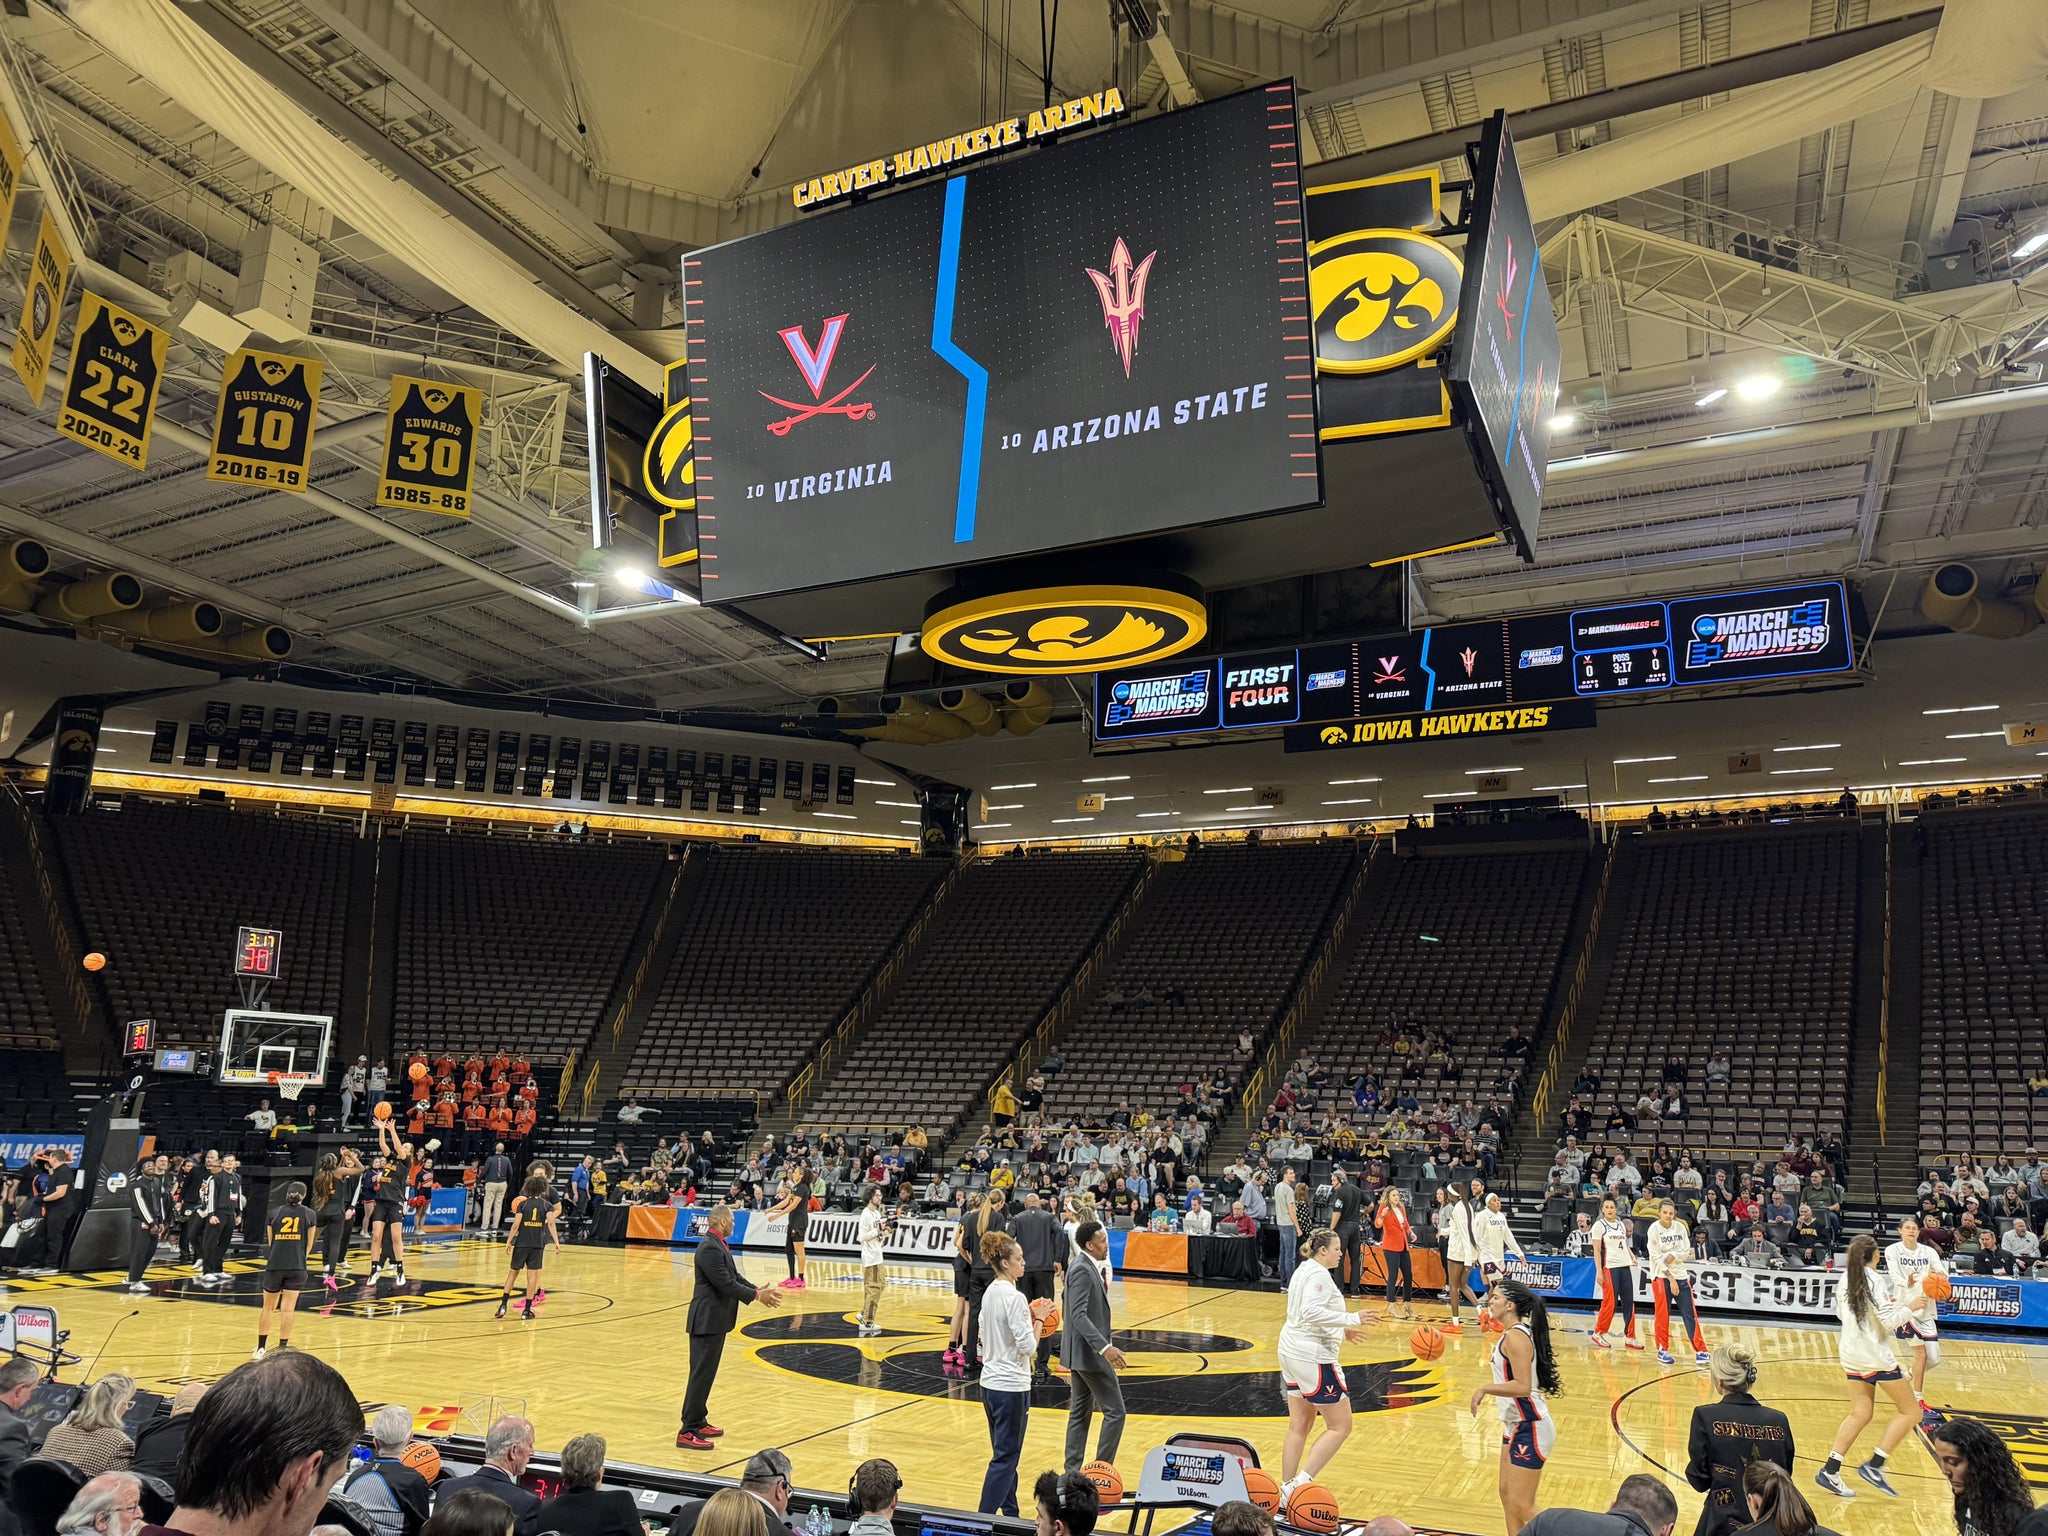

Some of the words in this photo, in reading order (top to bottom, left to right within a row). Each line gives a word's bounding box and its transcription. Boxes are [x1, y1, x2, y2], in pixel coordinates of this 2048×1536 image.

[792, 117, 1020, 208] CARVER-HAWKEYE
[1026, 87, 1124, 138] ARENA
[99, 345, 139, 373] CLARK
[80, 359, 146, 424] 22
[234, 391, 304, 411] GUSTAFSON
[1001, 433, 1022, 450] 10
[1032, 405, 1162, 454] ARIZONA
[1174, 382, 1268, 426] STATE
[236, 406, 294, 451] 10
[405, 418, 462, 436] EDWARDS
[63, 414, 141, 461] 2020-24
[398, 432, 462, 477] 30
[215, 460, 300, 485] 2016-19
[746, 484, 764, 500] 10
[774, 460, 893, 503] VIRGINIA
[385, 486, 466, 510] 1985-88
[1718, 610, 1789, 636] MARCH
[1727, 625, 1826, 654] MADNESS
[1612, 652, 1631, 662] POSS
[1651, 658, 1660, 670] 0
[1585, 665, 1593, 677] 0
[1612, 661, 1633, 674] 3:17
[1226, 665, 1294, 688] FIRST
[1617, 677, 1629, 686] 1ST
[1128, 680, 1180, 701] MARCH
[1445, 682, 1478, 692] ARIZONA
[1480, 681, 1503, 689] STATE
[1230, 686, 1290, 709] FOUR
[1376, 690, 1410, 699] VIRGINIA
[1135, 691, 1206, 714] MADNESS
[1352, 719, 1413, 743] IOWA
[1420, 706, 1549, 737] HAWKEYES
[2023, 727, 2036, 738] M
[1739, 757, 1750, 768] N
[1485, 778, 1501, 787] NN
[1084, 799, 1095, 807] LL
[1262, 791, 1278, 801] MM
[248, 933, 275, 948] 3:17
[242, 946, 270, 972] 30
[132, 1036, 146, 1050] 30
[532, 1208, 538, 1221] 1
[280, 1216, 300, 1233] 21
[766, 1224, 789, 1233] HOSTE
[808, 1219, 923, 1249] UNIVEITY
[928, 1226, 955, 1251] OF
[1618, 1241, 1624, 1250] 4
[1506, 1261, 1543, 1273] MARCH
[1900, 1256, 1917, 1267] LOCK
[1512, 1272, 1561, 1287] MADNESS
[1952, 1285, 1997, 1300] MARCH
[1958, 1300, 2020, 1314] MADNESS
[18, 1315, 49, 1328] Wilson
[414, 1448, 435, 1462] NCAA
[1175, 1455, 1209, 1470] MARCH
[1084, 1462, 1117, 1475] Wilson
[1179, 1467, 1223, 1481] MADNESS
